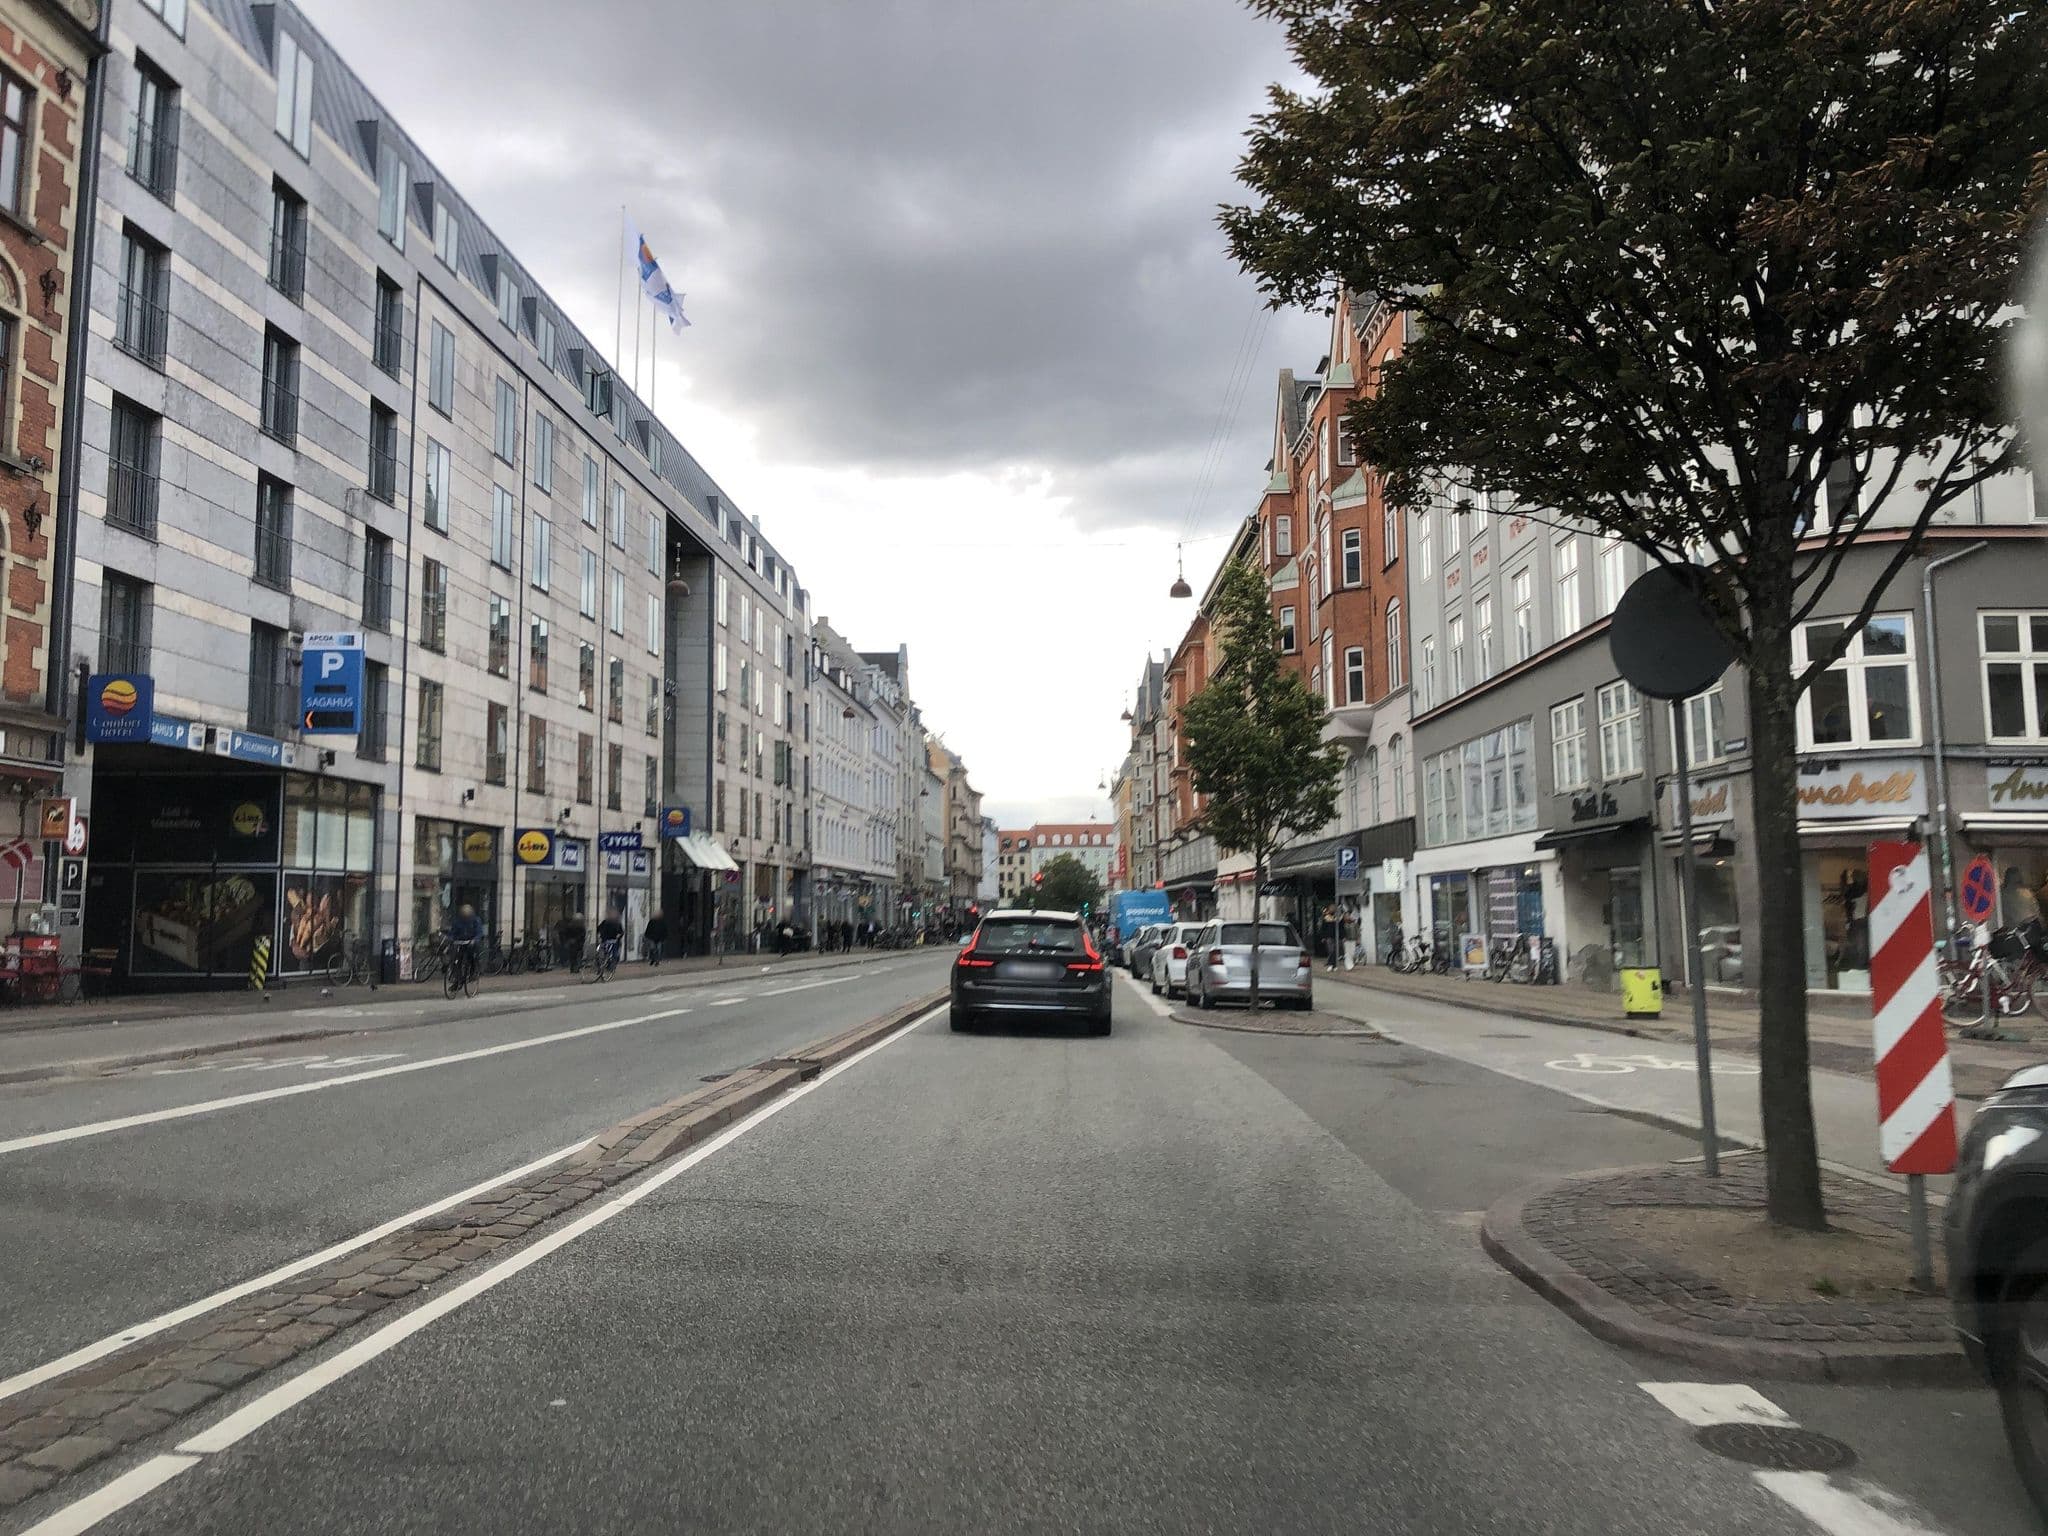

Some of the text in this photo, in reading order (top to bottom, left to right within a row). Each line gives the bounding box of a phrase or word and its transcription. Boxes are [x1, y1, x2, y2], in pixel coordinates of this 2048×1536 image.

[321, 652, 344, 678] P
[306, 697, 353, 707] SAGAHUS
[176, 726, 185, 741] P
[235, 736, 242, 750] P
[272, 745, 279, 758] P
[1796, 770, 1917, 806] nnabell
[606, 834, 639, 847] JYSK
[1341, 849, 1354, 866] P
[67, 863, 78, 887] P
